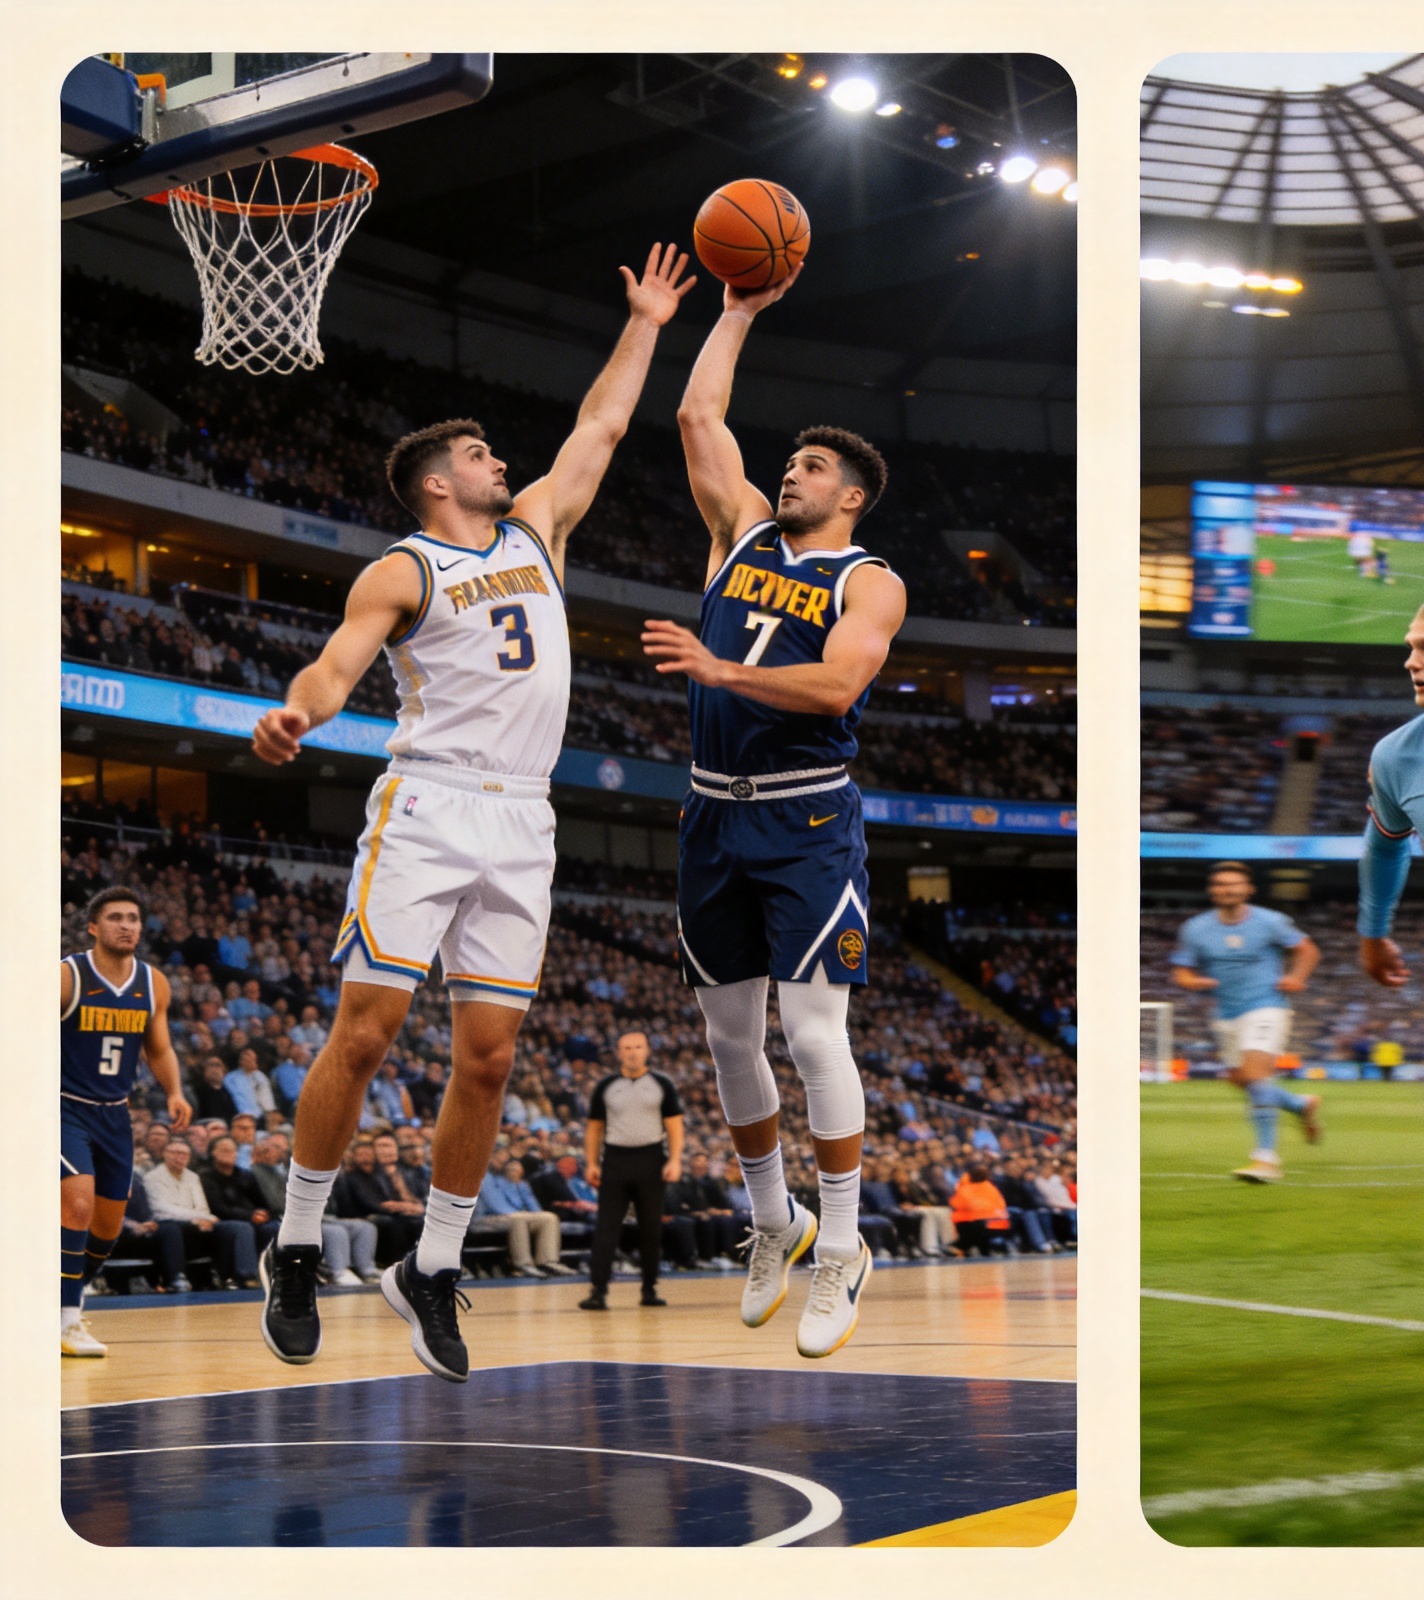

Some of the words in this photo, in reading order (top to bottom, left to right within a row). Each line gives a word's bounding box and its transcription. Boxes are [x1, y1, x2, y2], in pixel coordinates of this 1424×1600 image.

[489, 603, 536, 672] 3
[744, 611, 783, 666] 7
[98, 1036, 124, 1076] 5
